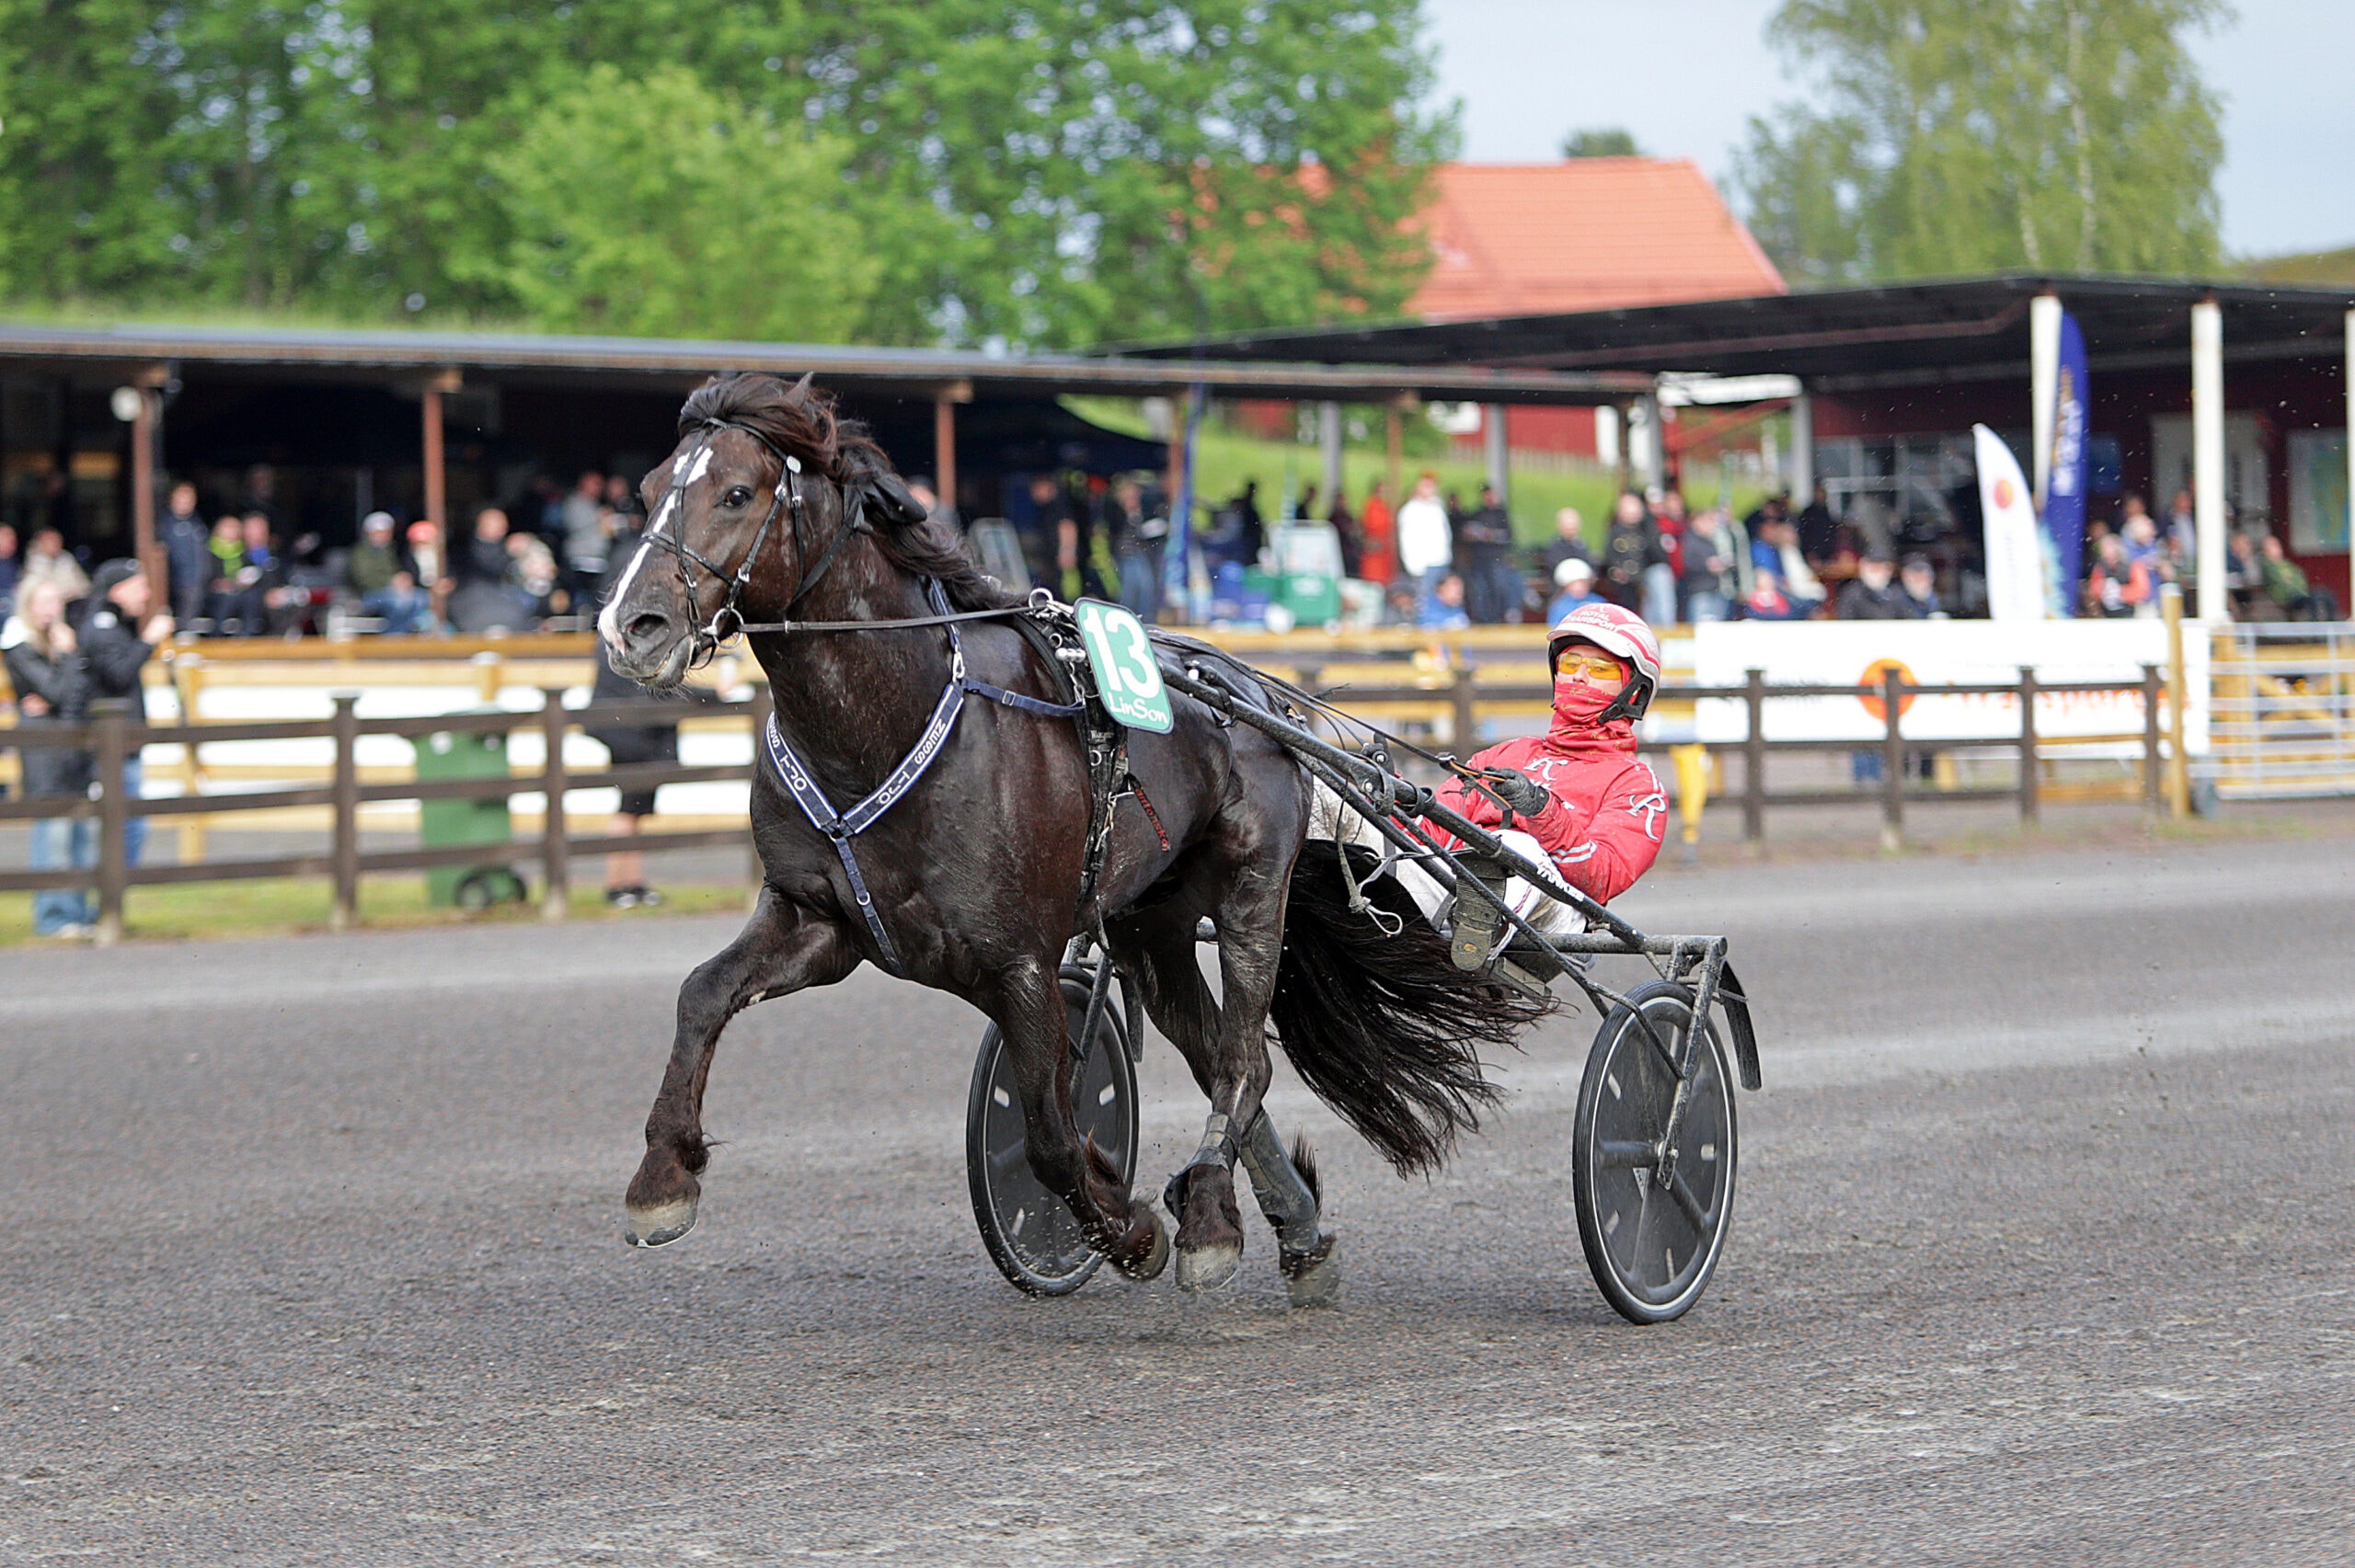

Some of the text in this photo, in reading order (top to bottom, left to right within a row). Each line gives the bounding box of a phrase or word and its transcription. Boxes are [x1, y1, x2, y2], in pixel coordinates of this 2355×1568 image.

[1083, 606, 1160, 698] 13
[1107, 691, 1168, 724] LinSon
[878, 718, 947, 806] NESS TJO
[1626, 793, 1667, 841] R
